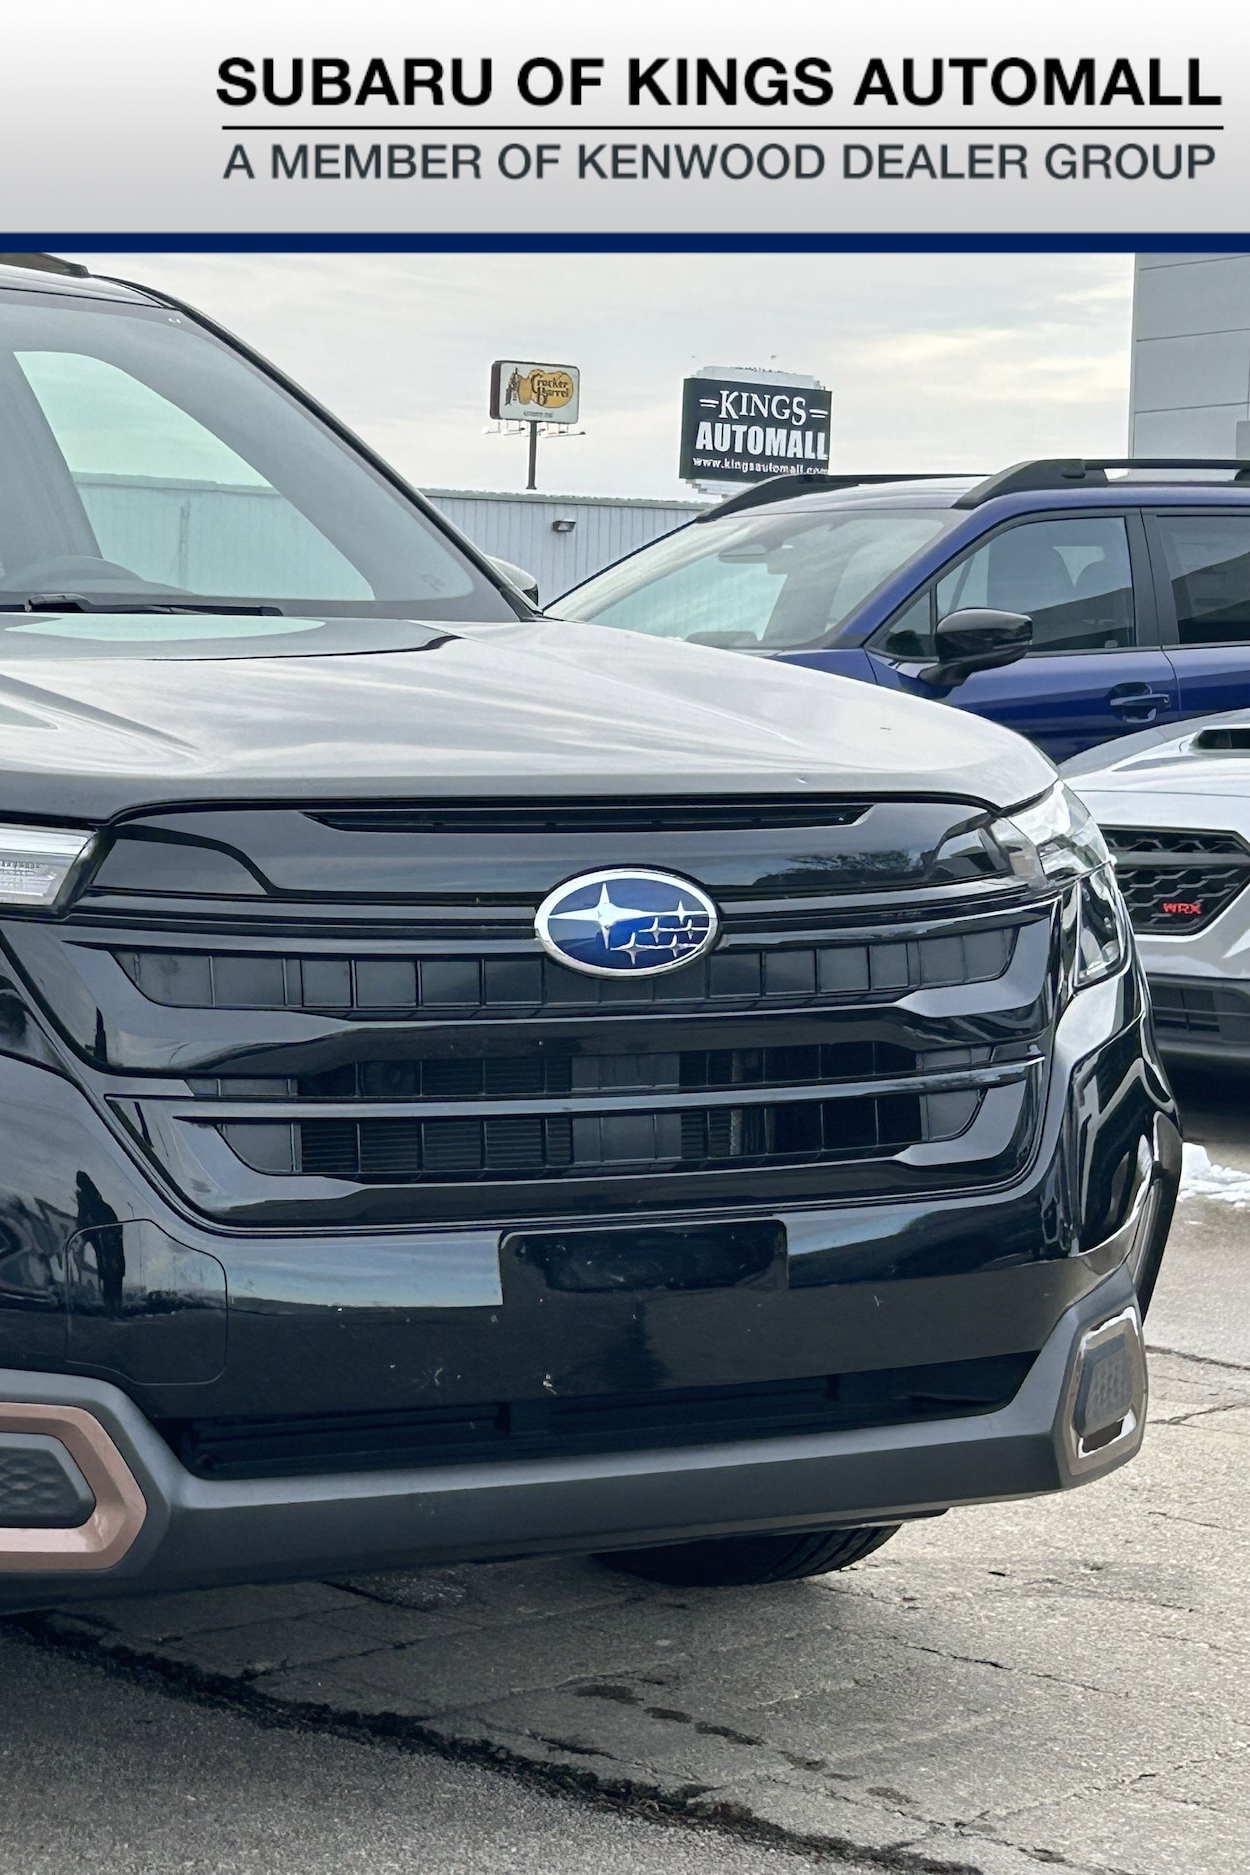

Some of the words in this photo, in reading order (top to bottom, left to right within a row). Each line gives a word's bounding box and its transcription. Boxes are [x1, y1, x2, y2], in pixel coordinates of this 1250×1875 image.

[530, 373, 568, 394] Cracker
[536, 386, 569, 406] Barrel
[718, 390, 807, 426] KINGS
[695, 421, 829, 461] AUTOMALL
[1162, 902, 1202, 915] WRX
